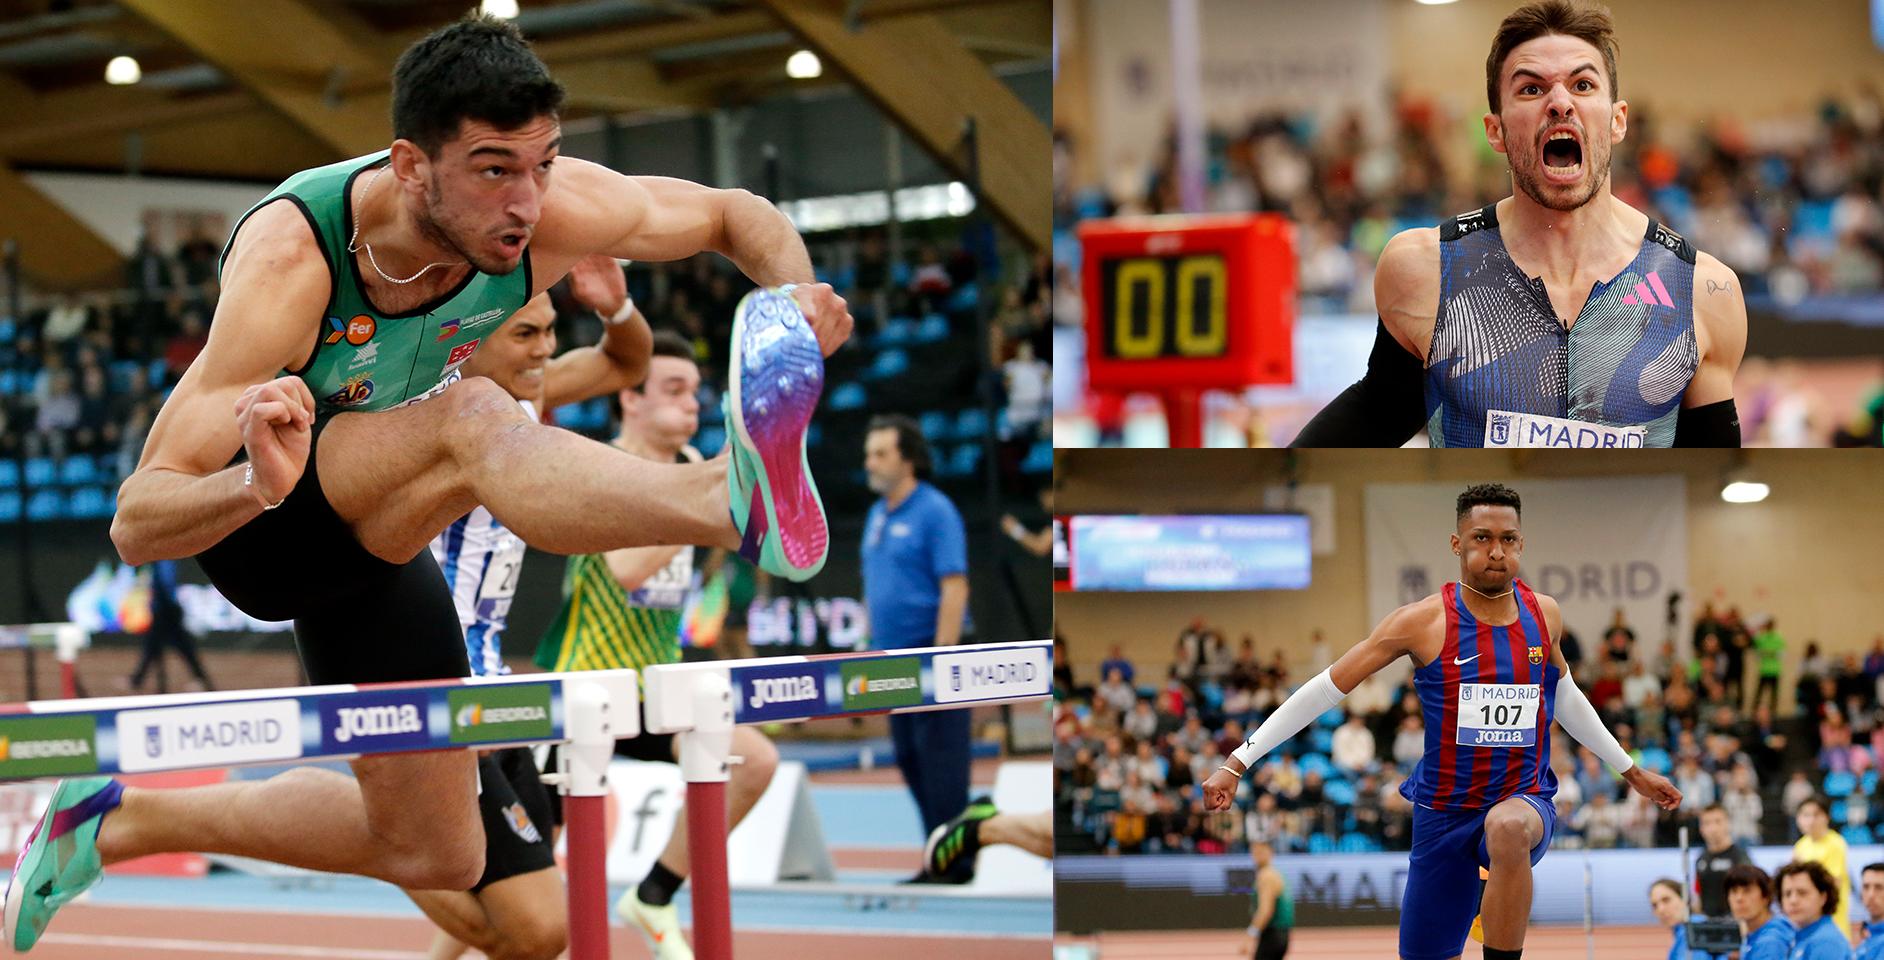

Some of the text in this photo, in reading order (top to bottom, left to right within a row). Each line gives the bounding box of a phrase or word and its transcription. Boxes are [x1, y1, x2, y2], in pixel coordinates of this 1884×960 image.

[1115, 255, 1227, 359] 00
[349, 322, 372, 335] Fer
[1529, 421, 1642, 448] MADRID
[1519, 560, 1662, 600] DRID
[971, 661, 1037, 686] MADRID
[1482, 687, 1539, 700] MADRID
[1480, 705, 1523, 726] 107
[178, 719, 282, 750] MADRID
